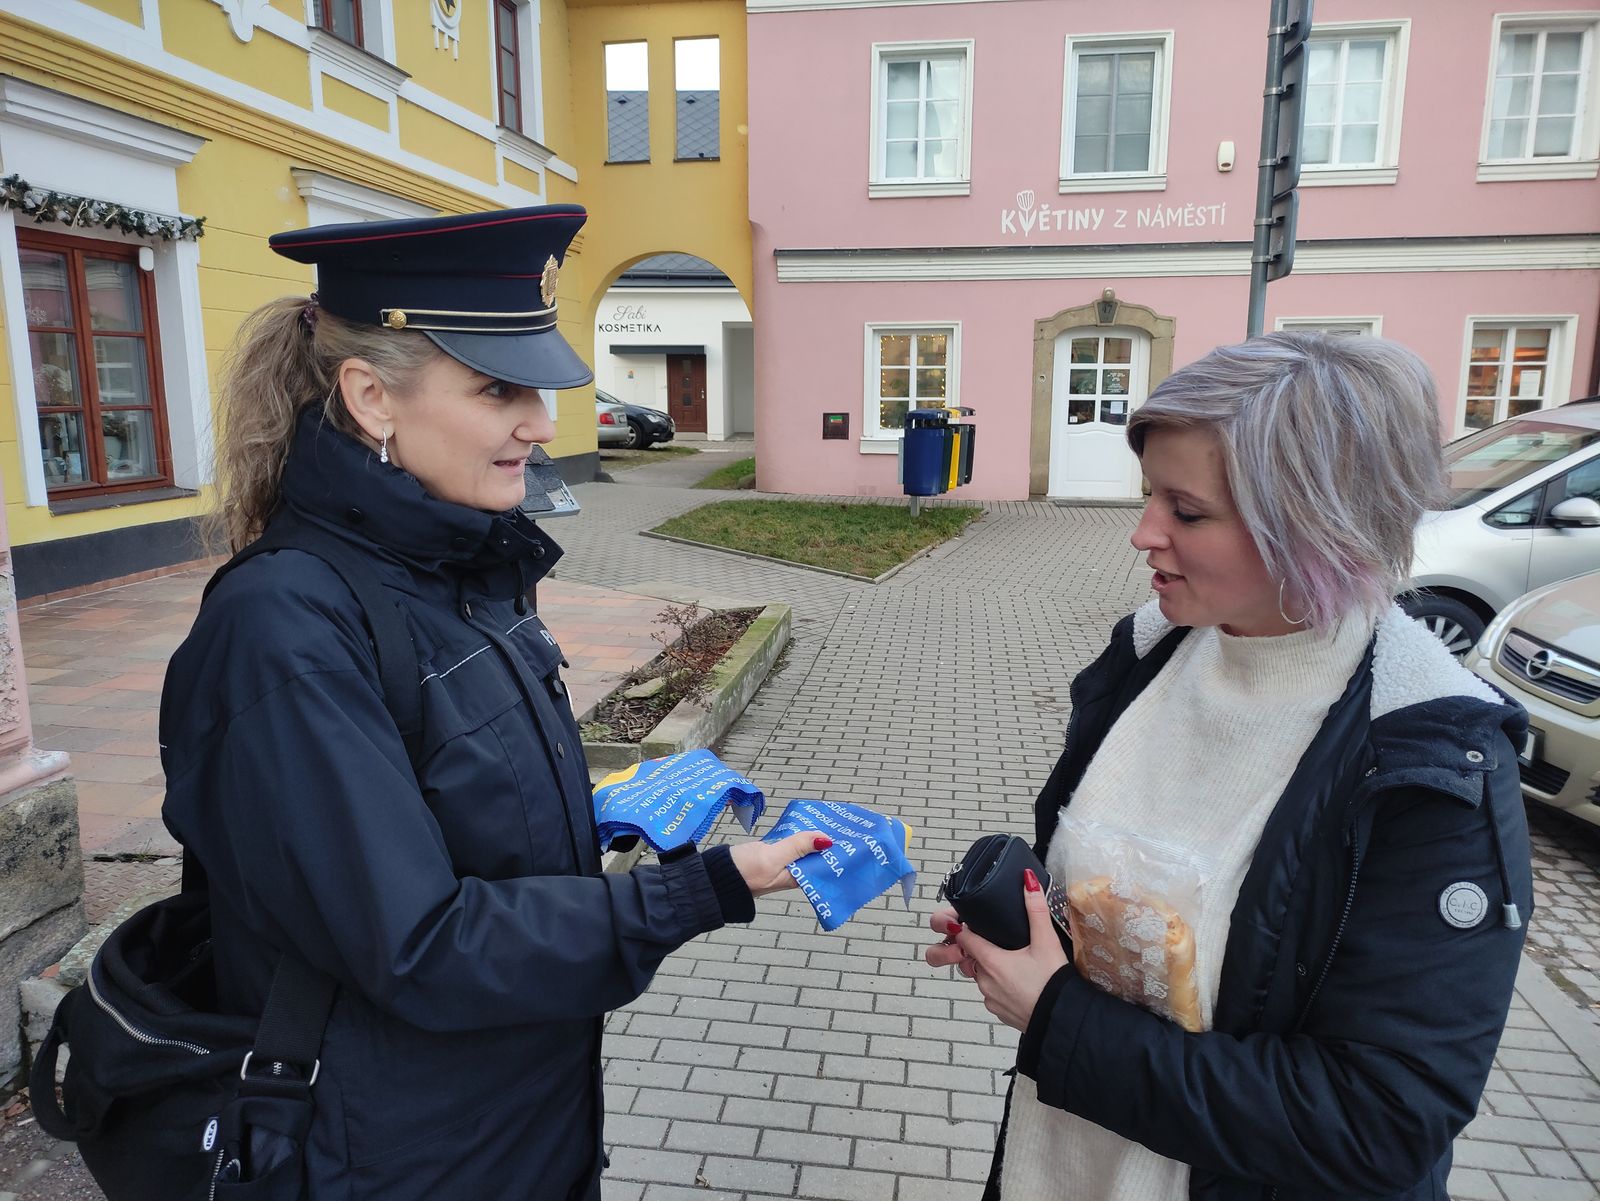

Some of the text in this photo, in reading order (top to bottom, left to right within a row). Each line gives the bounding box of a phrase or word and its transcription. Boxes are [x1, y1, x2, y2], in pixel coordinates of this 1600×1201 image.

[1001, 201, 1227, 237] KVĚTINY Z NÁMĚSTÍ
[598, 323, 662, 333] KOSMETIKA
[661, 801, 694, 836] VOLEJTE
[706, 781, 728, 795] 158
[859, 819, 876, 829] PIN
[803, 804, 841, 832] NEPOSÍLAT
[863, 834, 889, 866] KARTY
[788, 861, 832, 920] POLICIE ČR
[205, 1122, 216, 1147] IKEA
